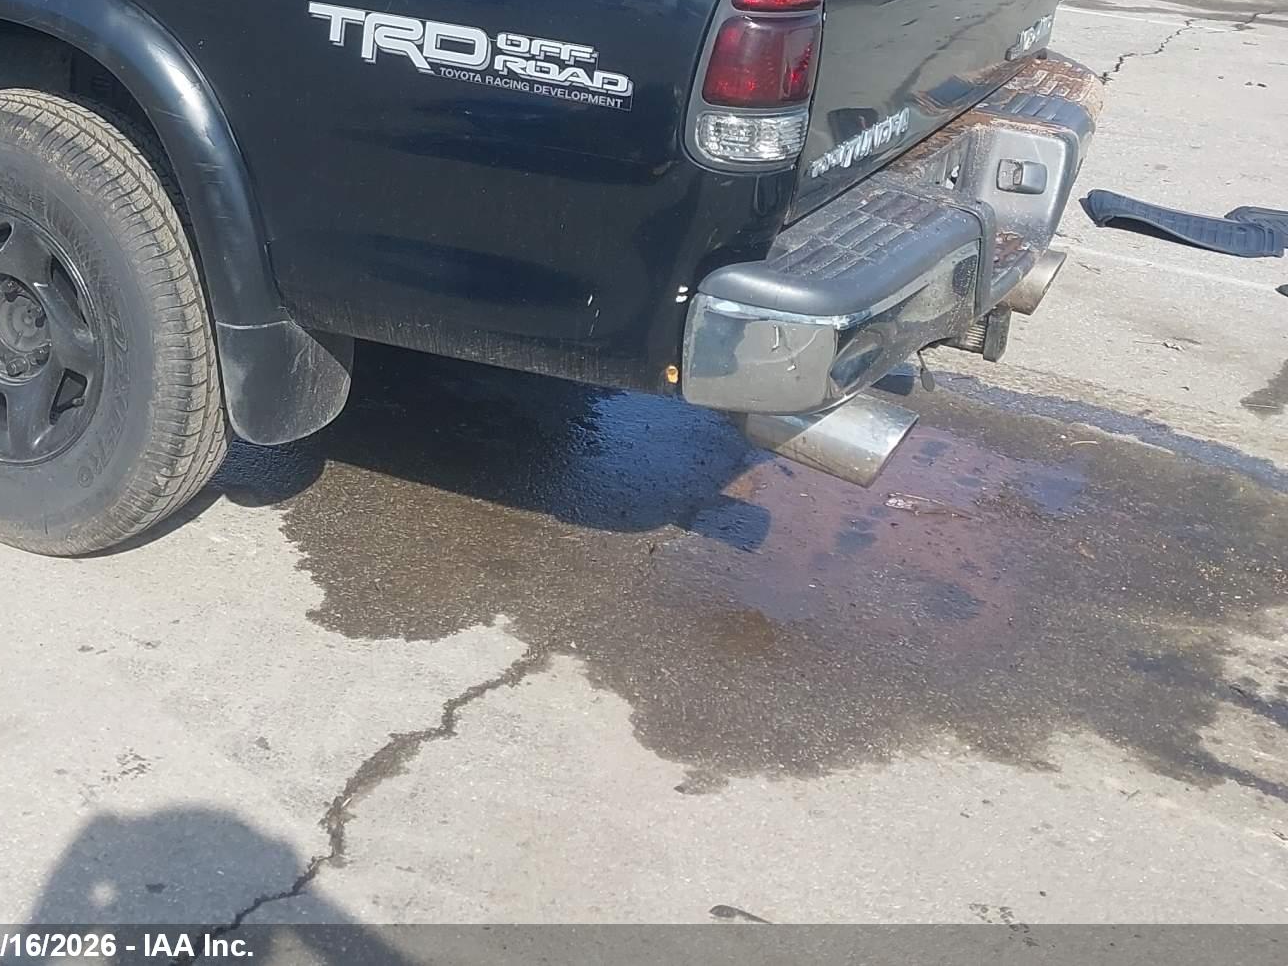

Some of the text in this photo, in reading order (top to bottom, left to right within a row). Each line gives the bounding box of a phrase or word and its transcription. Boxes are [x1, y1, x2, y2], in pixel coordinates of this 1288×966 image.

[308, 1, 598, 74] TRD OFF
[439, 67, 624, 109] TOYOTA RACING DEVELOPMENT
[493, 54, 634, 97] ROAD
